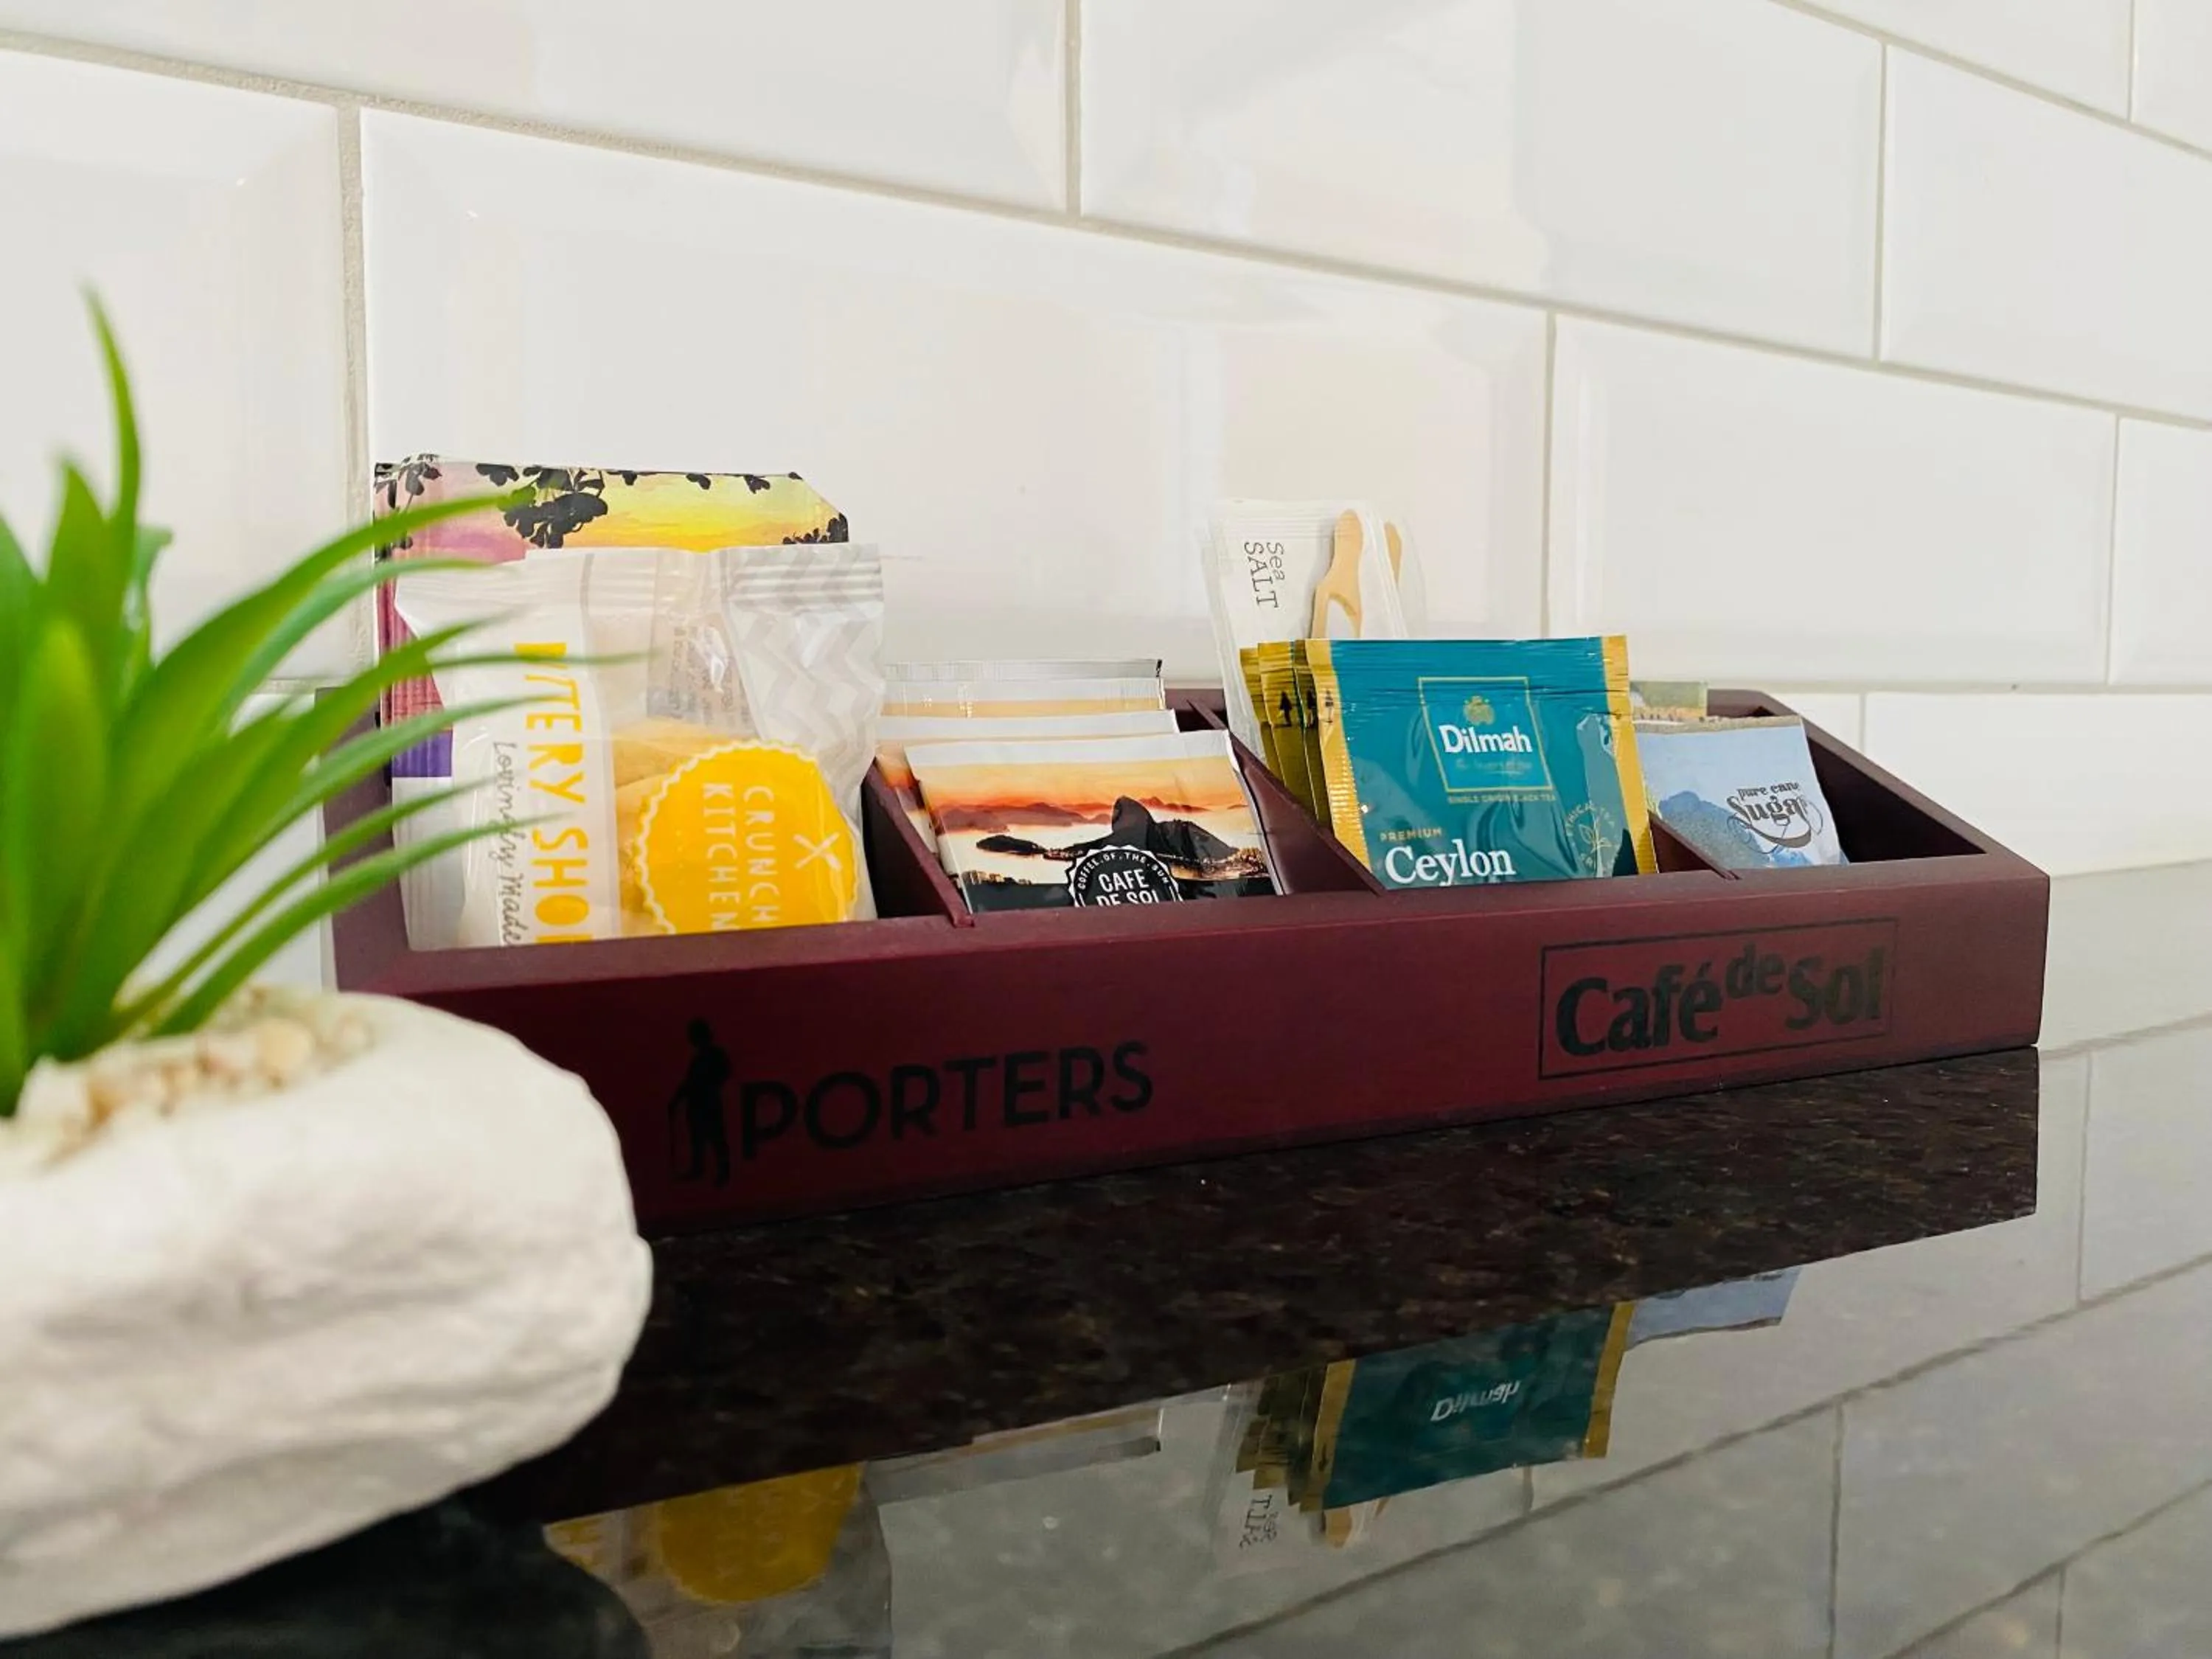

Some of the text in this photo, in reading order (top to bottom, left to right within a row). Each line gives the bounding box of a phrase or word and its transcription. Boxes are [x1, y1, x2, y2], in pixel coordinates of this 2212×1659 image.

[1244, 541, 1279, 608] SALT
[1266, 541, 1286, 580] Sea
[1439, 723, 1534, 754] Dilmah
[702, 782, 741, 931] KITCHEN
[742, 785, 781, 922] CRUNCH
[1124, 852, 1146, 863] THE
[1380, 827, 1442, 842] PREMIUM
[1385, 838, 1517, 887] Ceylon
[529, 827, 594, 945] SHO
[1098, 868, 1150, 893] CAFE
[1555, 961, 1724, 1057] Café
[1725, 940, 1784, 1000] de
[739, 1040, 1154, 1161] PORTERS
